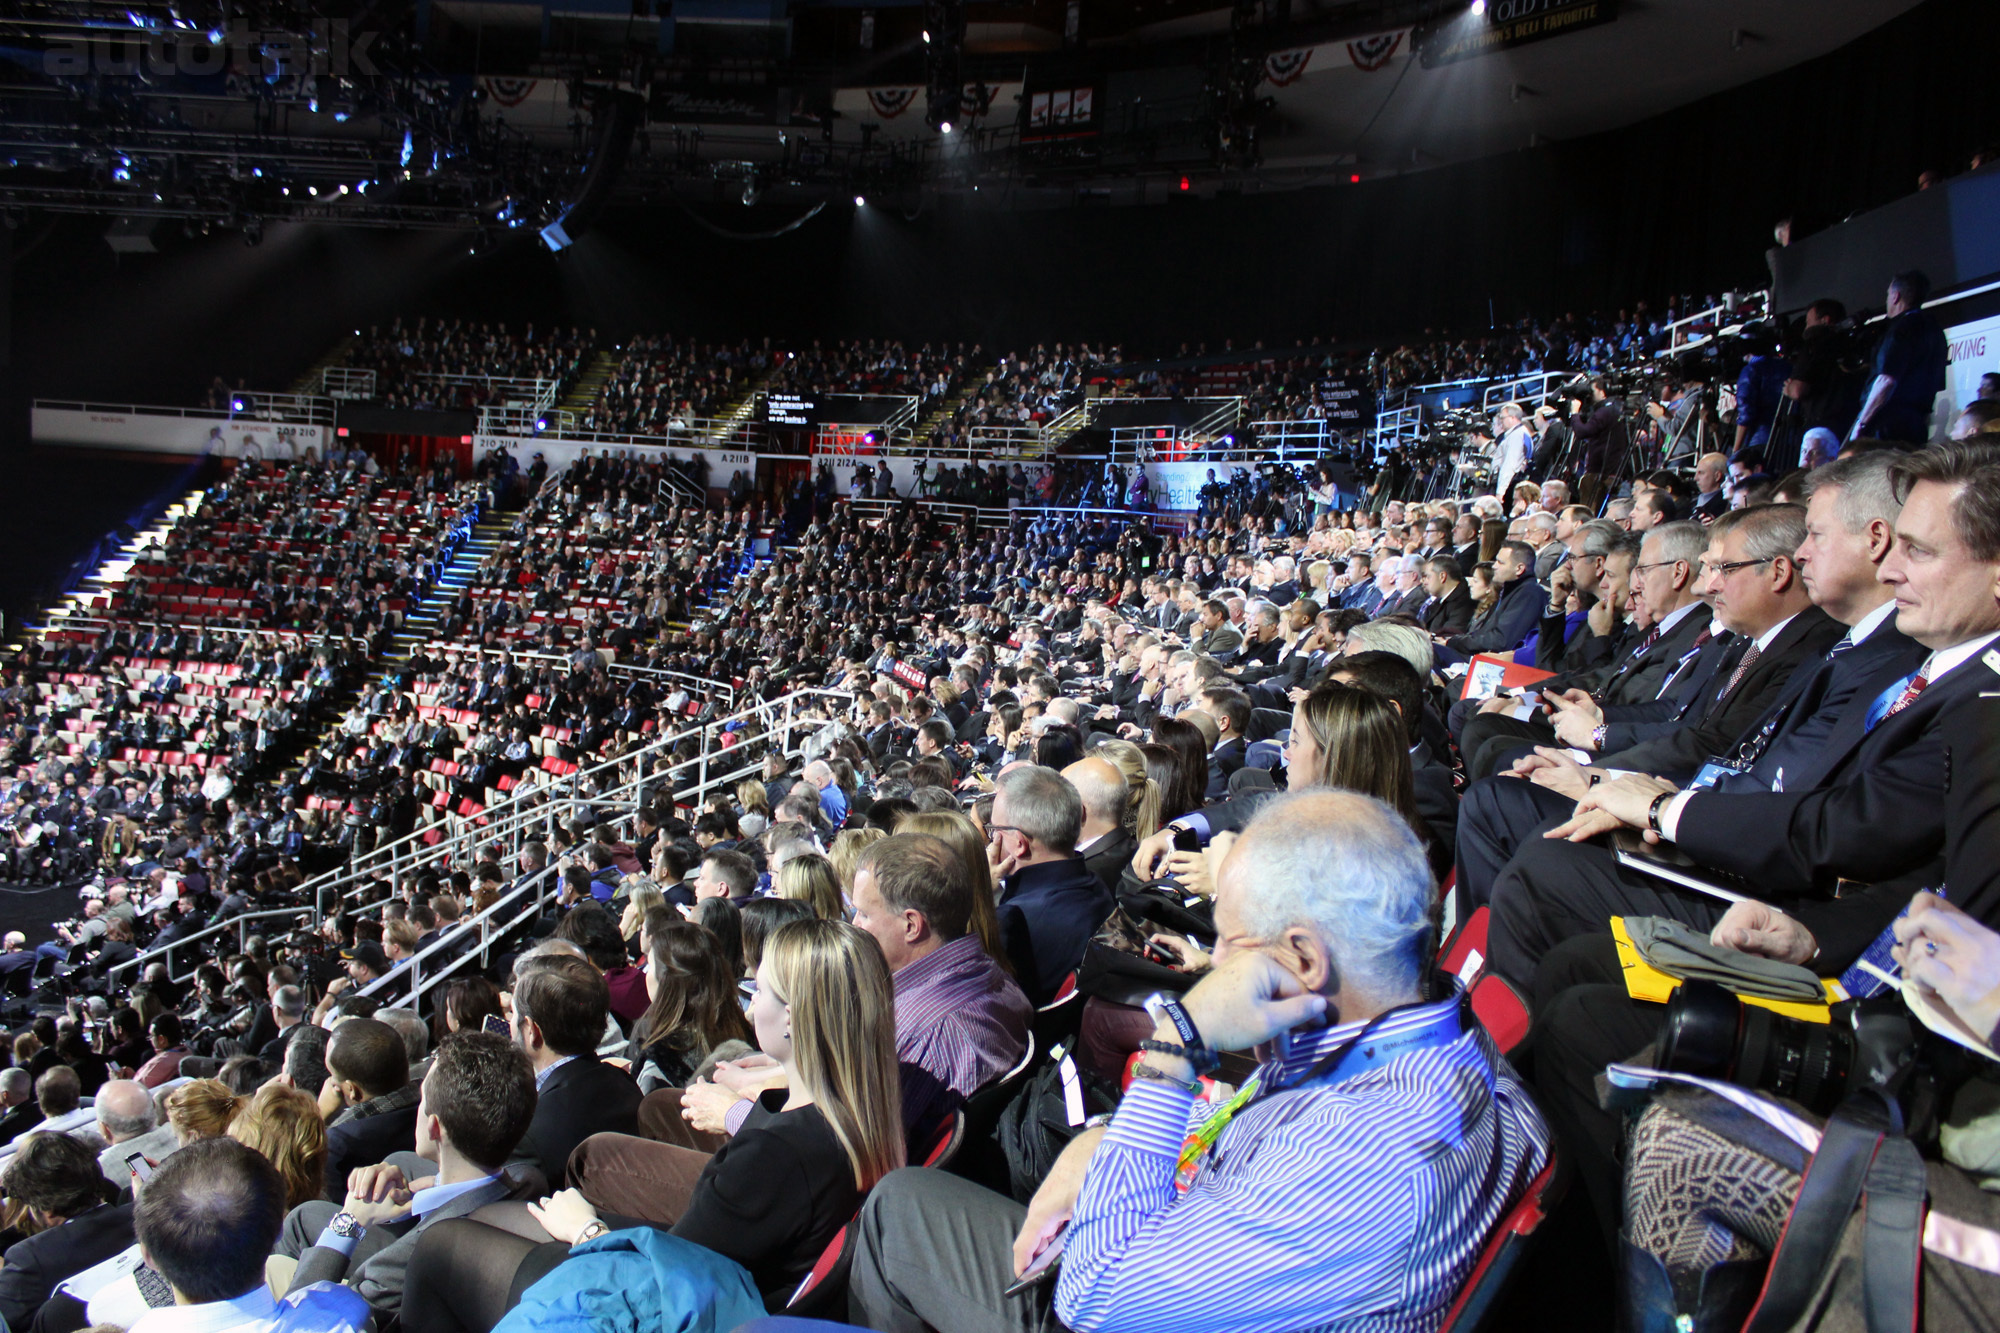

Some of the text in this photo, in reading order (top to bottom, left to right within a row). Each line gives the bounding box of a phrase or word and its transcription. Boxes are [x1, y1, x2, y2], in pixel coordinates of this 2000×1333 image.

[1515, 18, 1540, 39] DELI
[1543, 3, 1597, 30] FAVORITE
[299, 428, 316, 437] 210
[1176, 1020, 1192, 1042] SHOW
